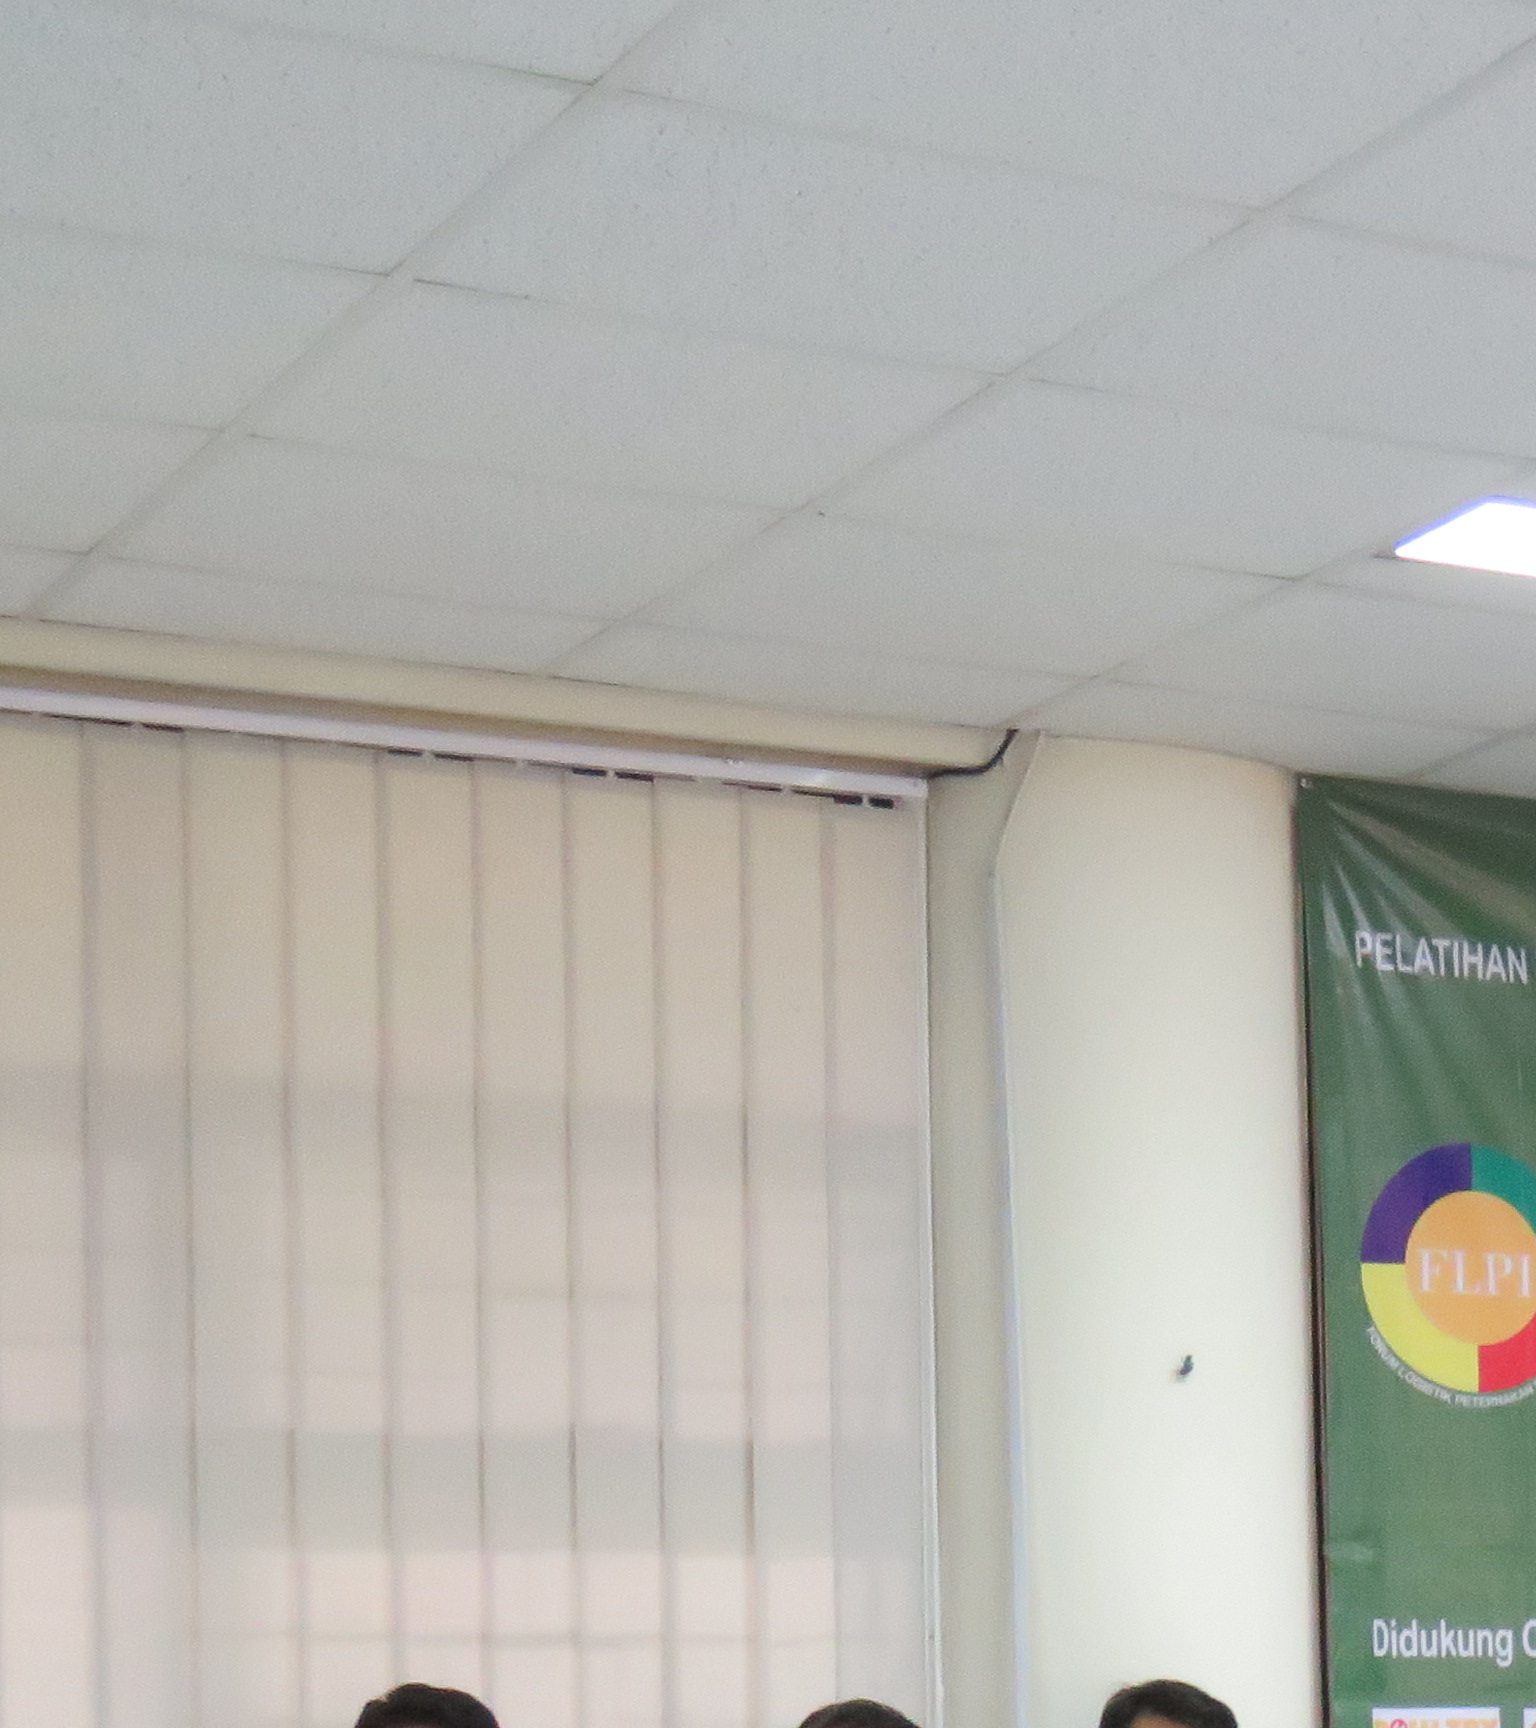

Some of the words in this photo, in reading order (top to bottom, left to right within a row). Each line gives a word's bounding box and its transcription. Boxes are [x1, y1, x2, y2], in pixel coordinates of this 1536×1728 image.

[1355, 930, 1528, 985] PELATIHAN
[1417, 1248, 1532, 1298] FLPI
[1373, 1618, 1514, 1667] Didukung
